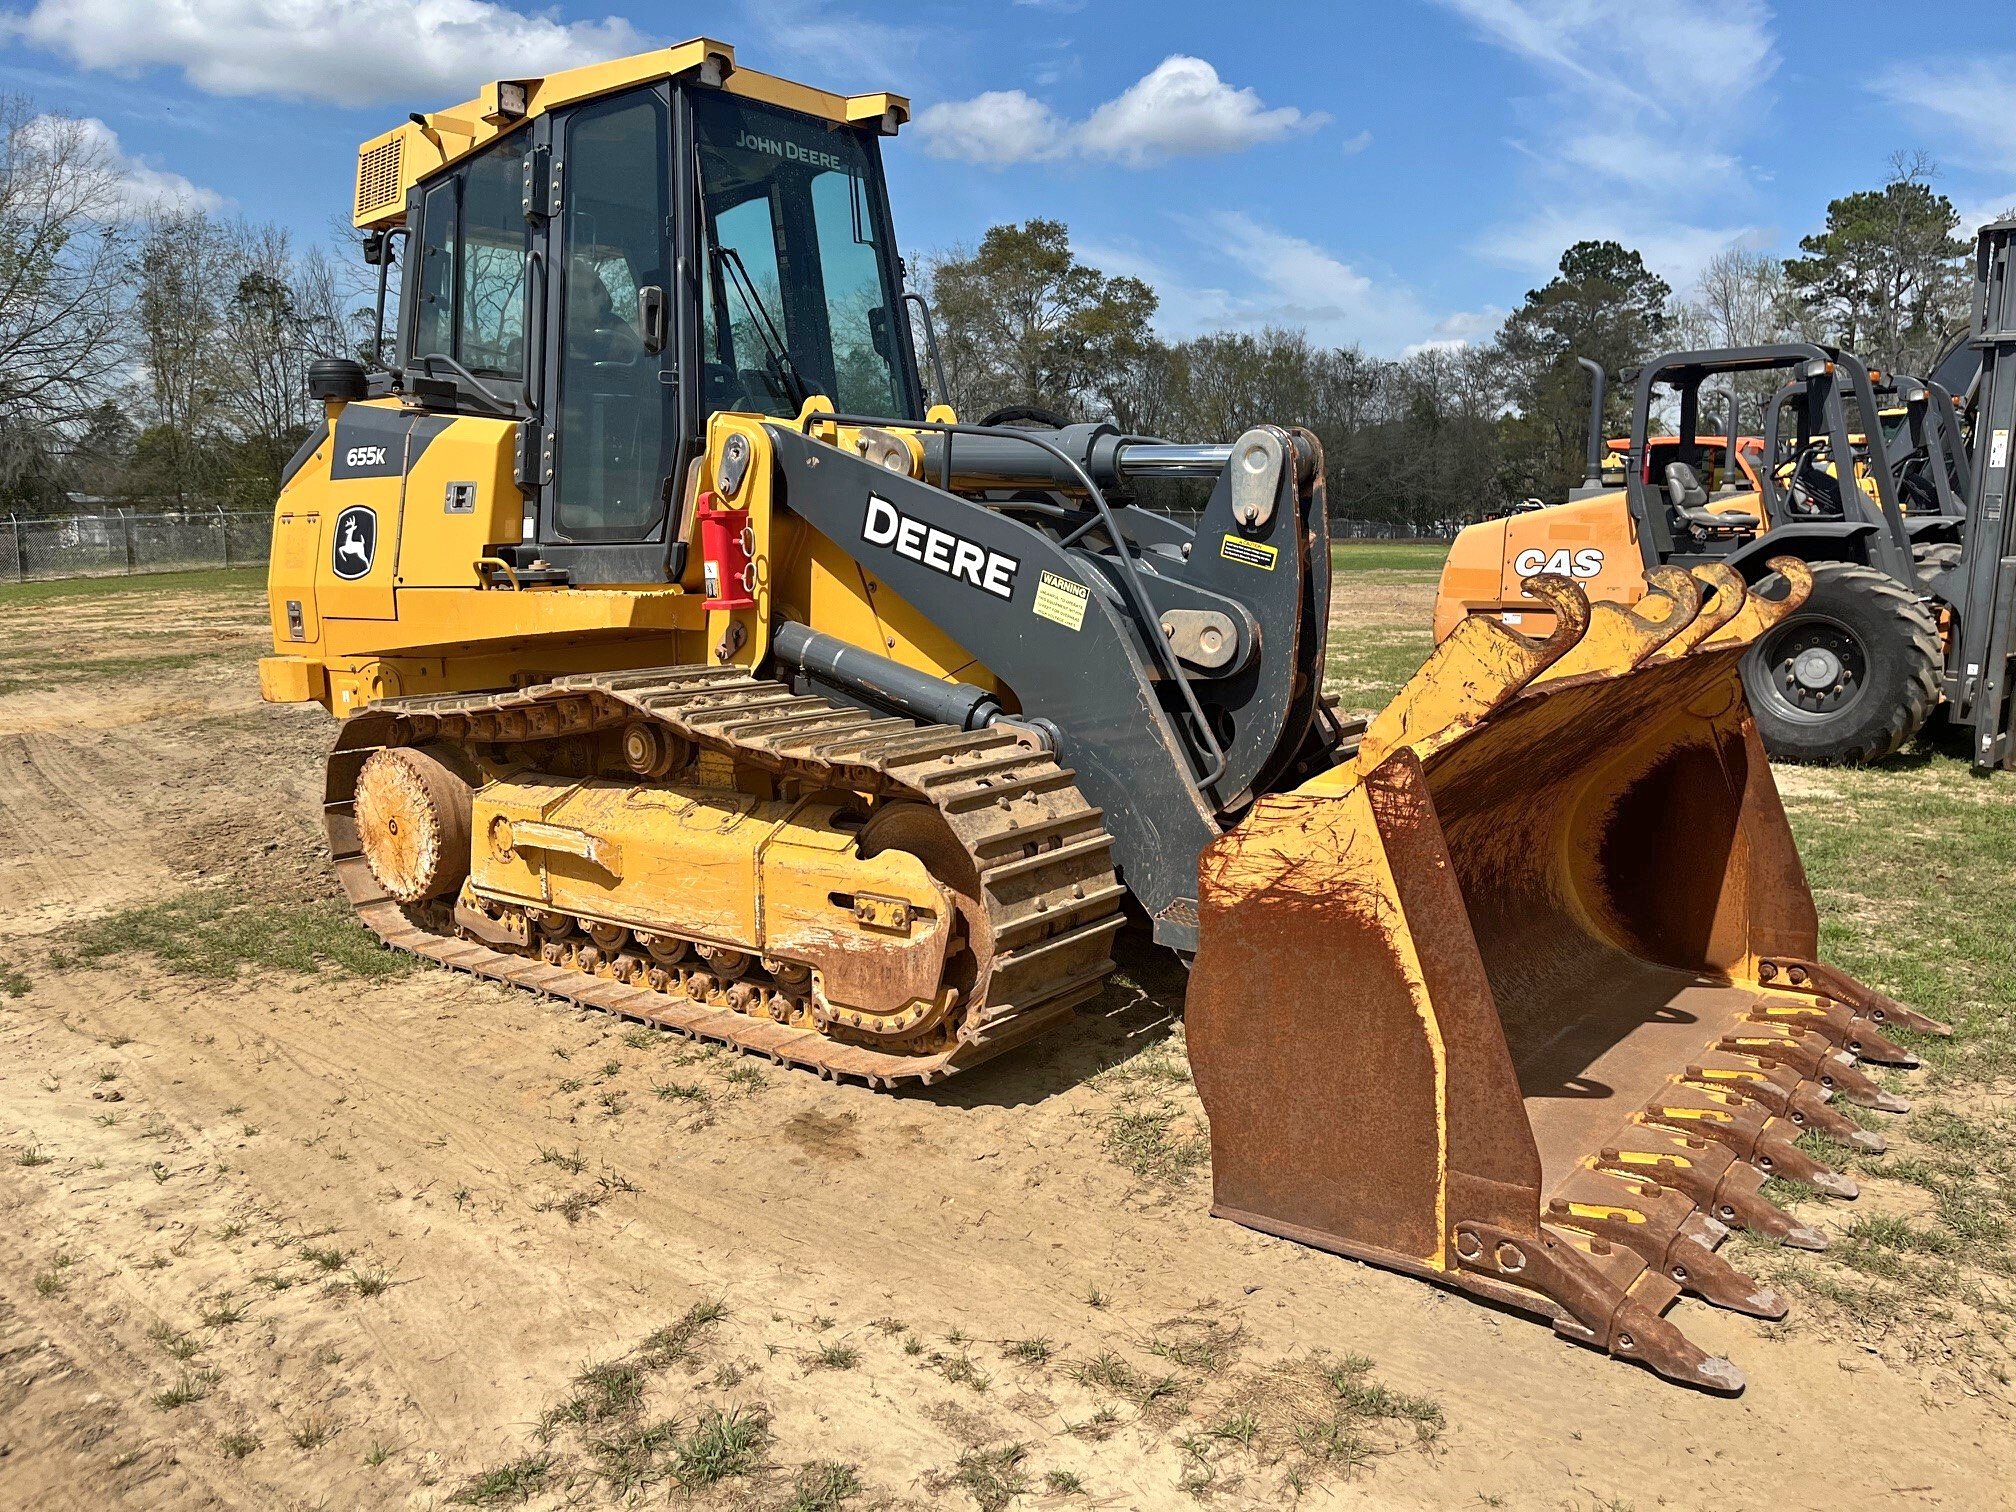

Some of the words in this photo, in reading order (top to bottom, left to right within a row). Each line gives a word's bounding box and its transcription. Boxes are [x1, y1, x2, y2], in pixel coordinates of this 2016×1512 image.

[736, 130, 783, 157] JOHN
[785, 140, 841, 170] DEERE
[347, 446, 387, 467] 655K
[863, 495, 1018, 598] DEERE
[1514, 548, 1604, 578] CAS
[1043, 573, 1087, 599] WARNING
